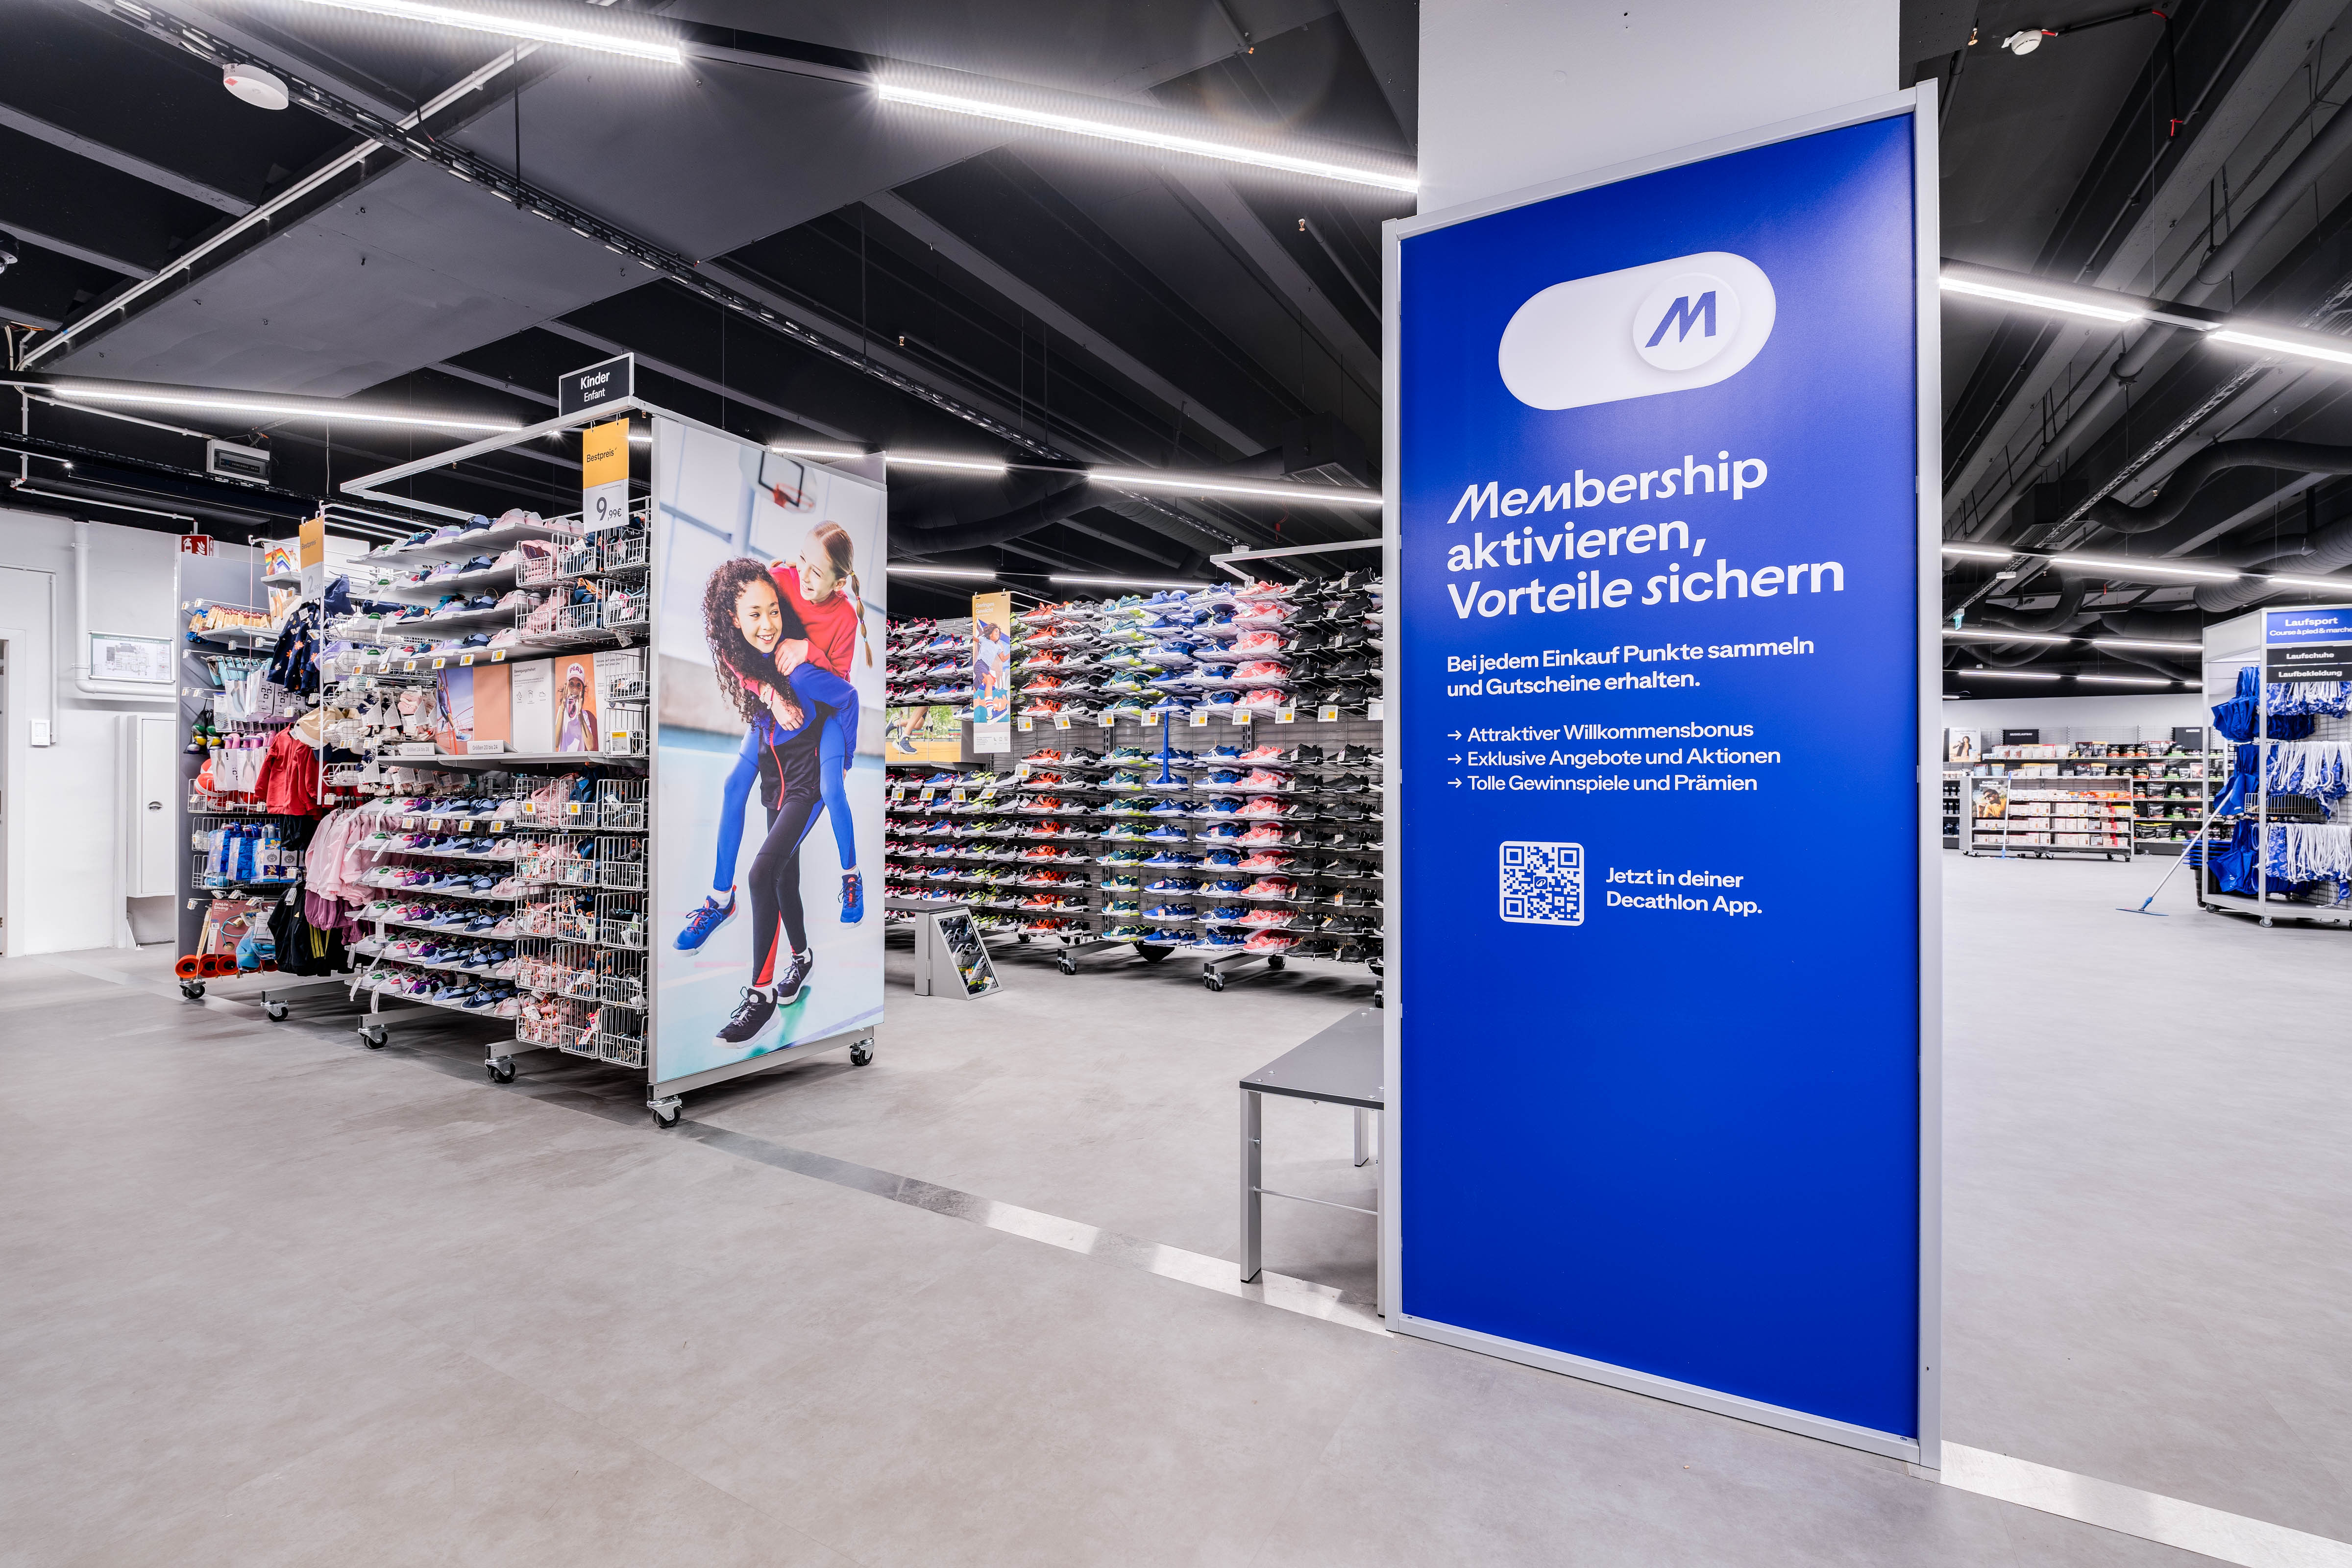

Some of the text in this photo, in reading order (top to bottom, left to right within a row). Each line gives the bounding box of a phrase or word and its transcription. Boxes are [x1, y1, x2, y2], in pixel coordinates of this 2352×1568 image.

[581, 371, 610, 390] Kinder
[584, 388, 606, 402] Enfant
[587, 449, 614, 463] Bestpreis
[1447, 450, 1767, 524] Membership
[596, 497, 622, 521] 9,99€
[301, 539, 317, 550] Bestpreis
[1447, 521, 1706, 572] aktivieren,
[1447, 559, 1843, 618] Vorteile sichern
[2285, 617, 2338, 626] Laufsport
[1448, 637, 1813, 674] Bei jedem Einkauf Punkte sammeln
[569, 665, 583, 674] PLAY
[1448, 671, 1700, 696] und Gutscheine erhalten.
[1468, 722, 1753, 741] Attraktiver Willkommensbonus
[1469, 748, 1780, 769] Exklusive Angebote und Aktionen
[1468, 775, 1757, 794] Tolle Gewinnspiele und Prämien
[1606, 868, 1743, 887] Jetzt in deiner
[1607, 891, 1762, 916] Decathlon App.
